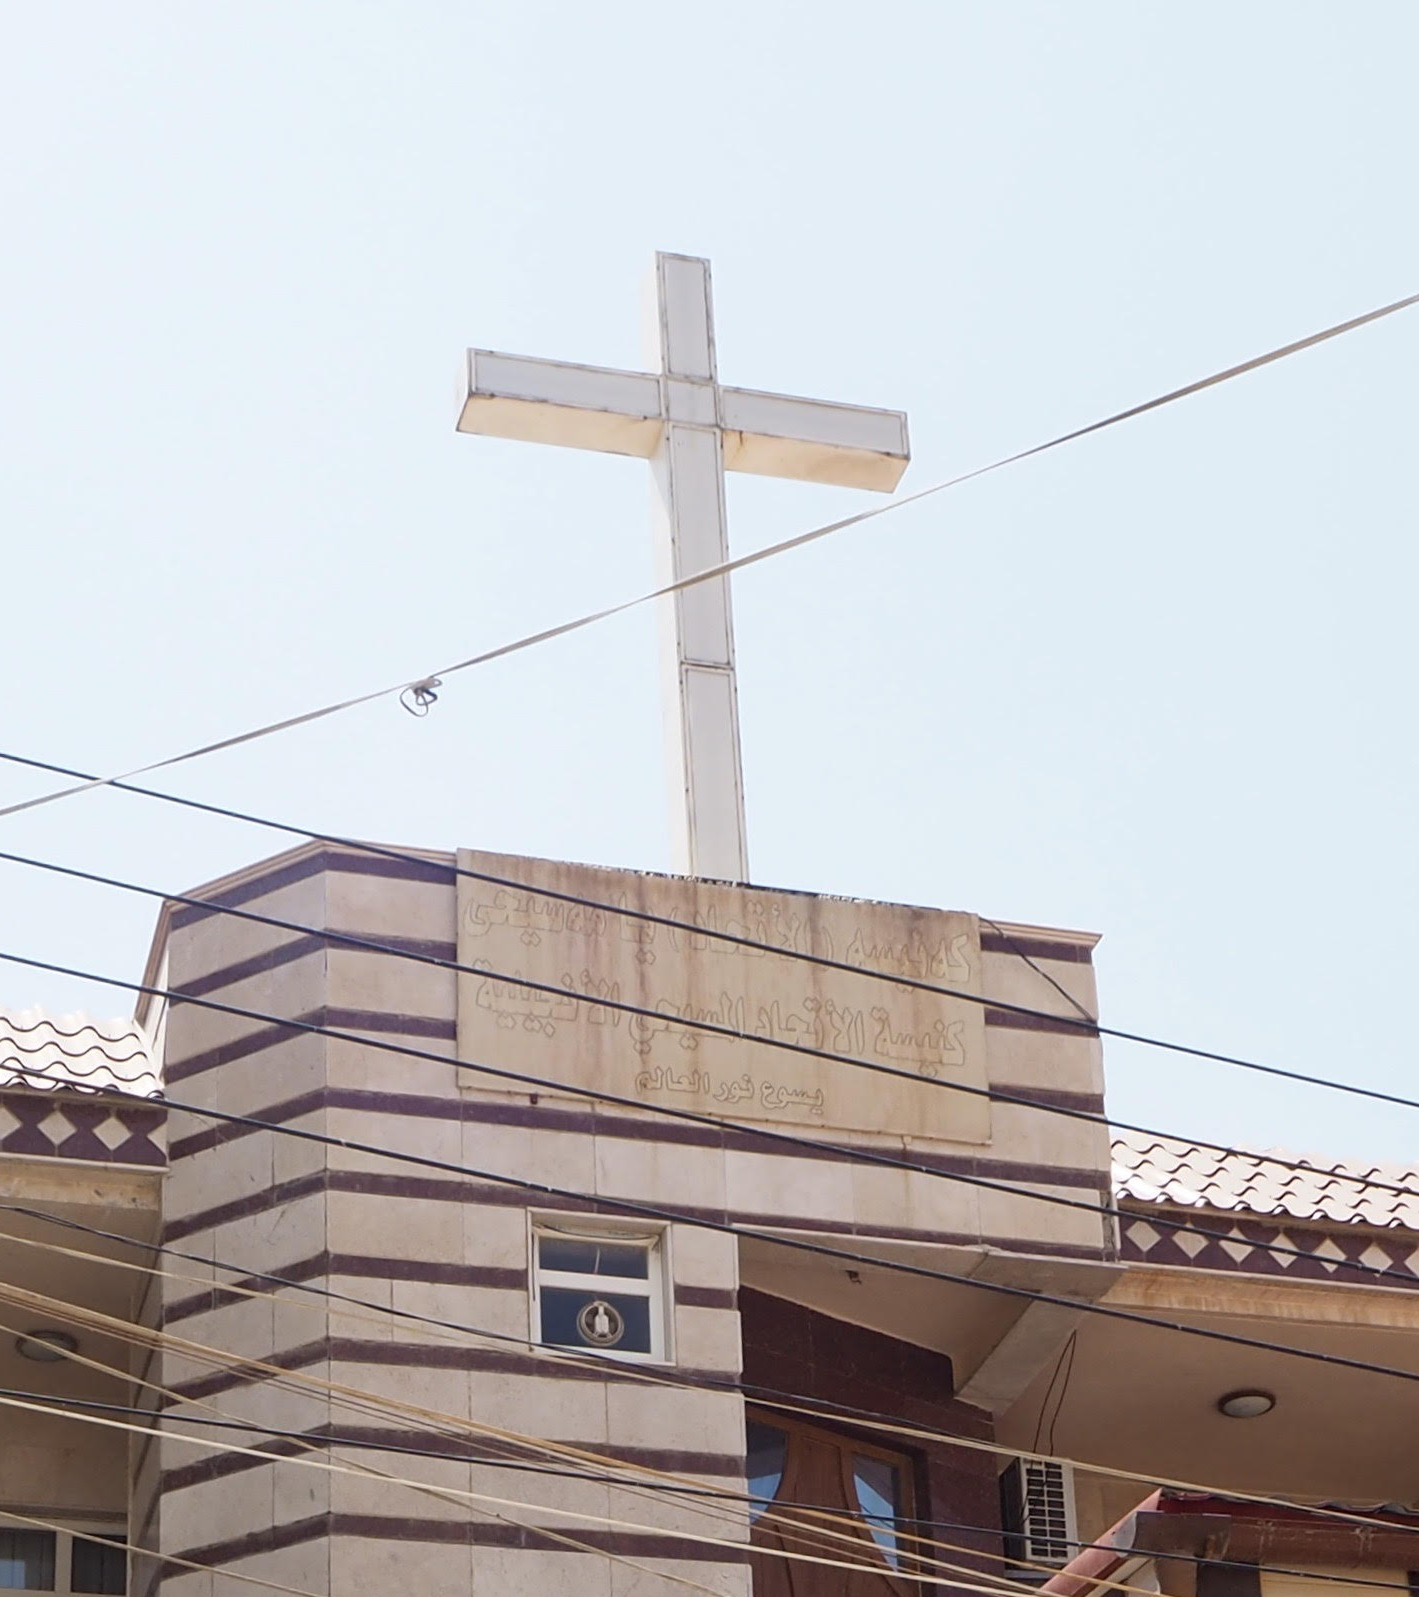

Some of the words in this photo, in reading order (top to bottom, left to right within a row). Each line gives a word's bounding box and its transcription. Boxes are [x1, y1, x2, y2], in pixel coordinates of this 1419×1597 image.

[634, 1064, 711, 1096] العالم
[712, 1073, 755, 1104] نور
[759, 1080, 825, 1115] يسوع
